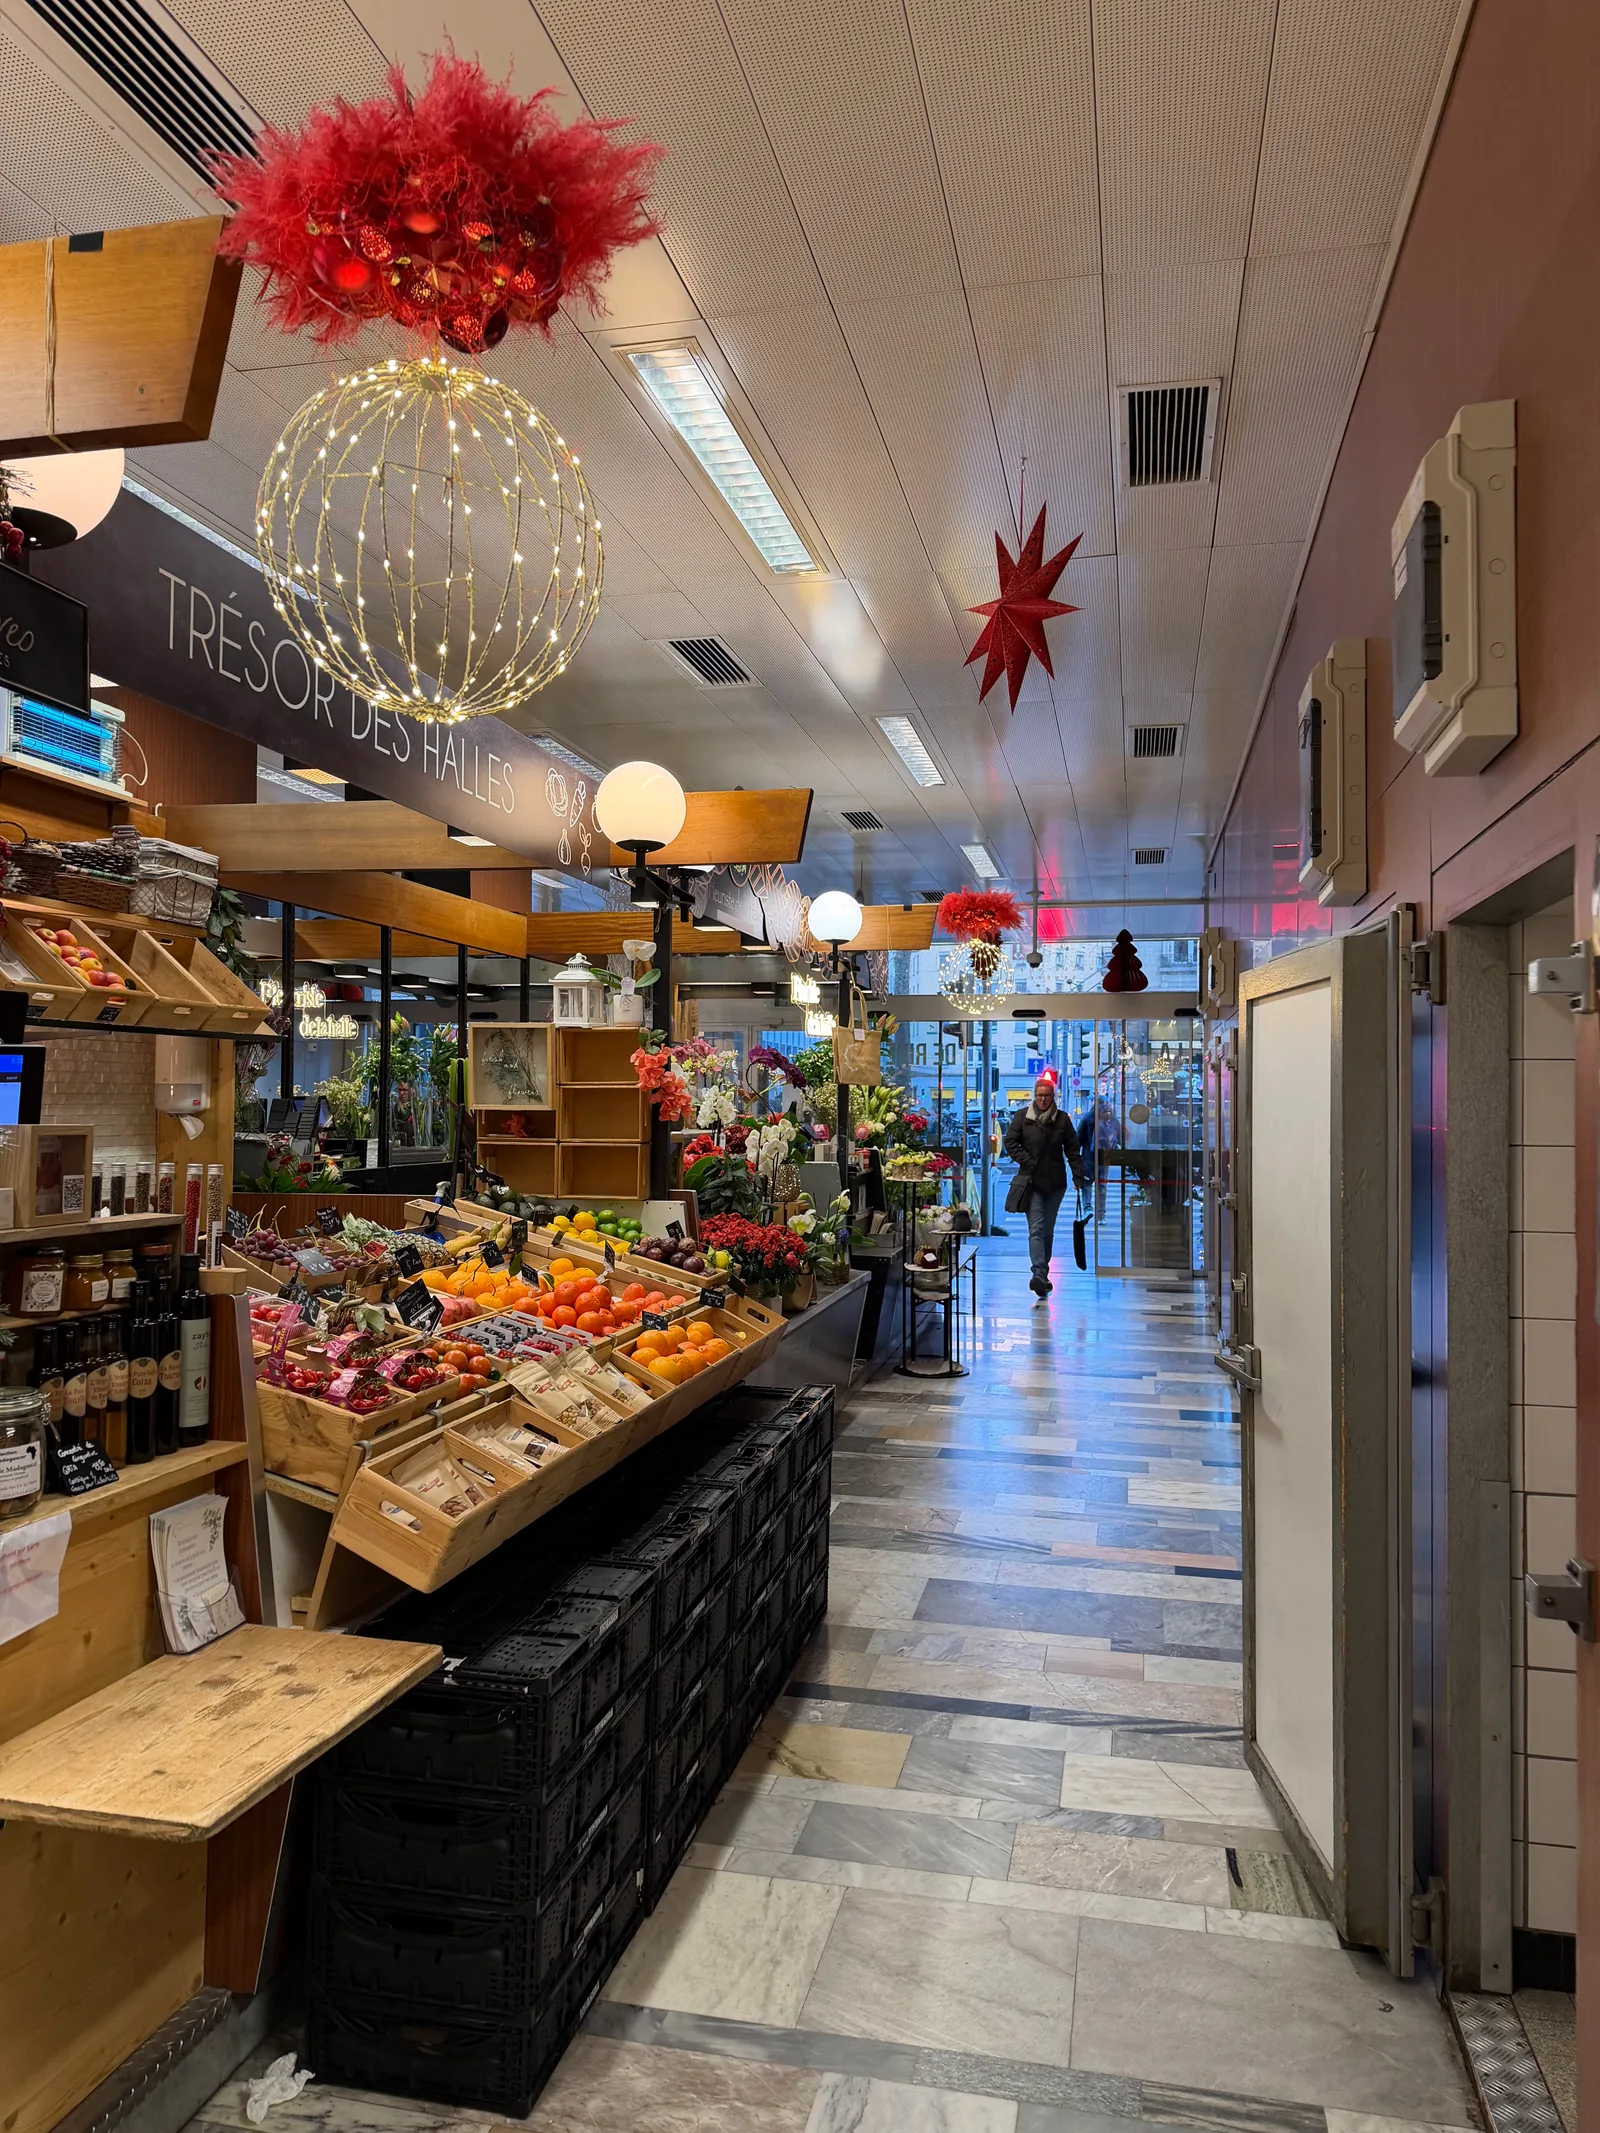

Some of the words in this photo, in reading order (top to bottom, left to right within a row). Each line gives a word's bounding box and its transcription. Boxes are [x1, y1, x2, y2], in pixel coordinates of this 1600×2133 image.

[159, 567, 335, 728] TRÉSOR
[351, 692, 411, 763] DES
[423, 720, 515, 814] HALLES
